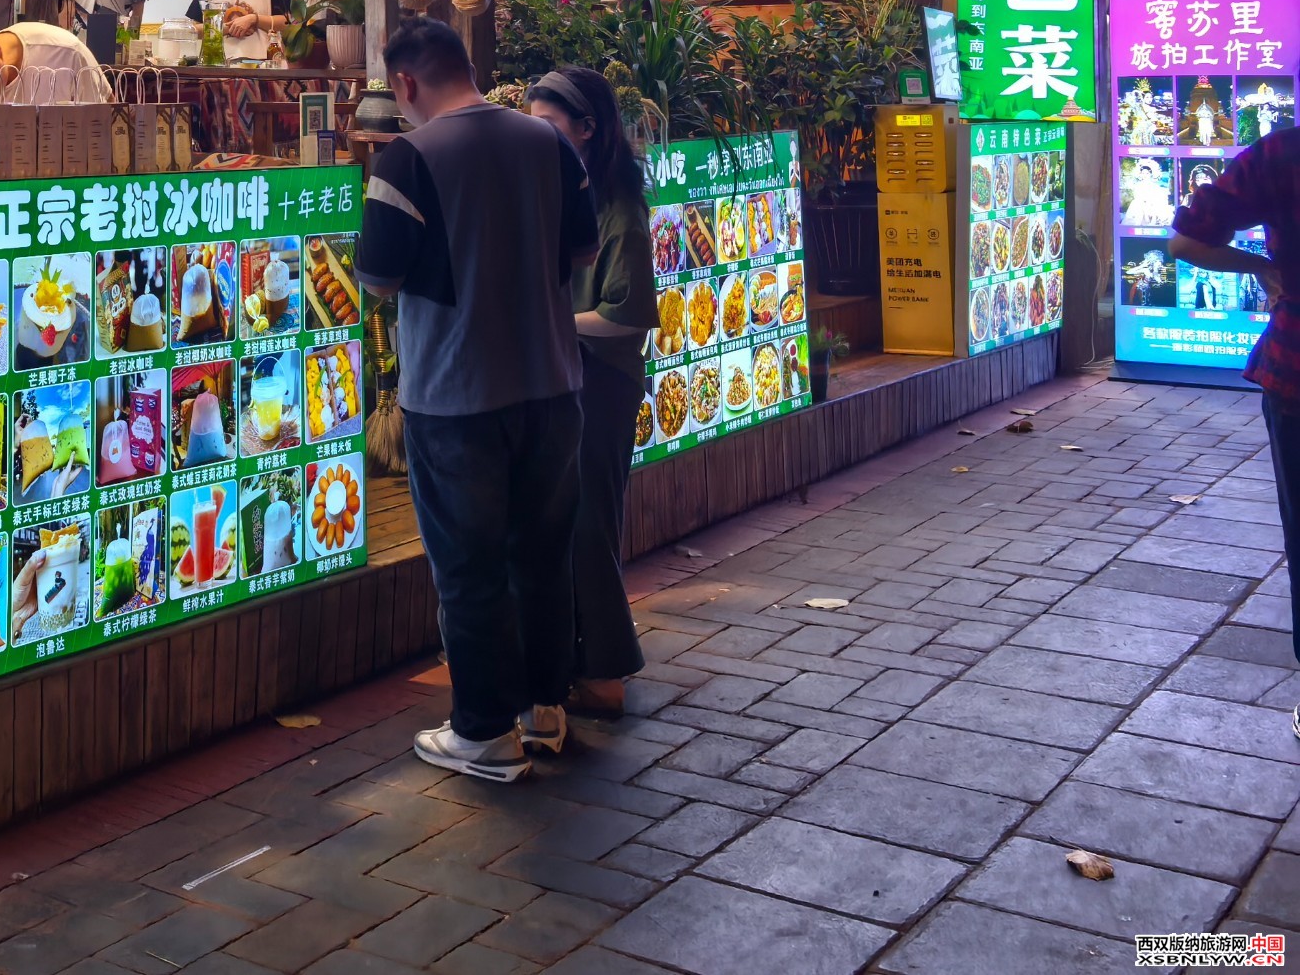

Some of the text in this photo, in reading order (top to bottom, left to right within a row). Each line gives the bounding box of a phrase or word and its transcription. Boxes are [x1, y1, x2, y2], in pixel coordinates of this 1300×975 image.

[1129, 37, 1285, 71] 旅拍工作室
[989, 127, 1041, 149] 云南特色菜
[277, 183, 354, 221] 十年老店
[28, 366, 77, 388] 芒果椰子冻
[12, 495, 91, 526] 泰式手标红茶绿茶
[36, 636, 66, 659] 泡鲁达
